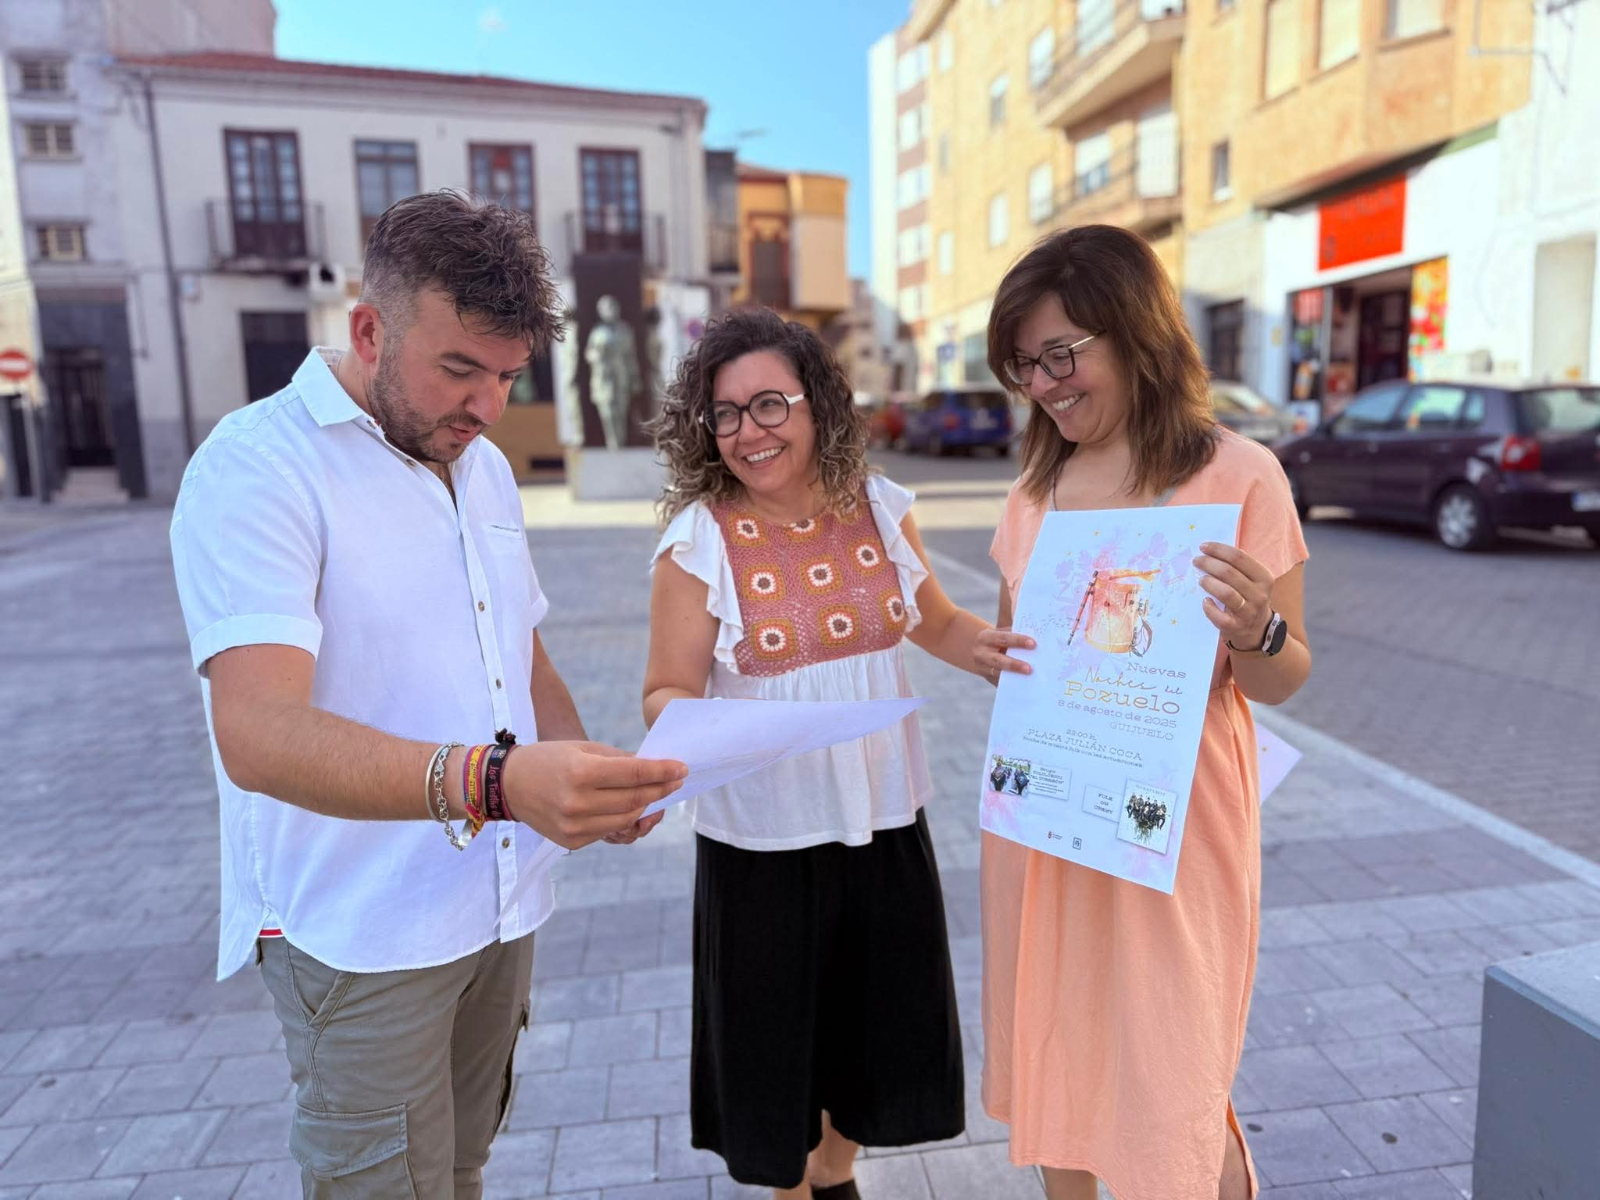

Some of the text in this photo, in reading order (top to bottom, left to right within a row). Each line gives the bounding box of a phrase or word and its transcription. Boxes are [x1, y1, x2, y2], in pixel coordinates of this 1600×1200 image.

[1084, 665, 1183, 695] Noches del
[1126, 661, 1187, 679] Nuevas
[1064, 680, 1181, 715] Pozuelo
[1066, 700, 1081, 710] de
[1083, 705, 1123, 718] agosto
[1124, 711, 1142, 722] de
[1143, 715, 1177, 728] 2025
[1027, 728, 1143, 761] PLAZA JULIÁN COCA
[1109, 721, 1174, 741] GUIJUELO
